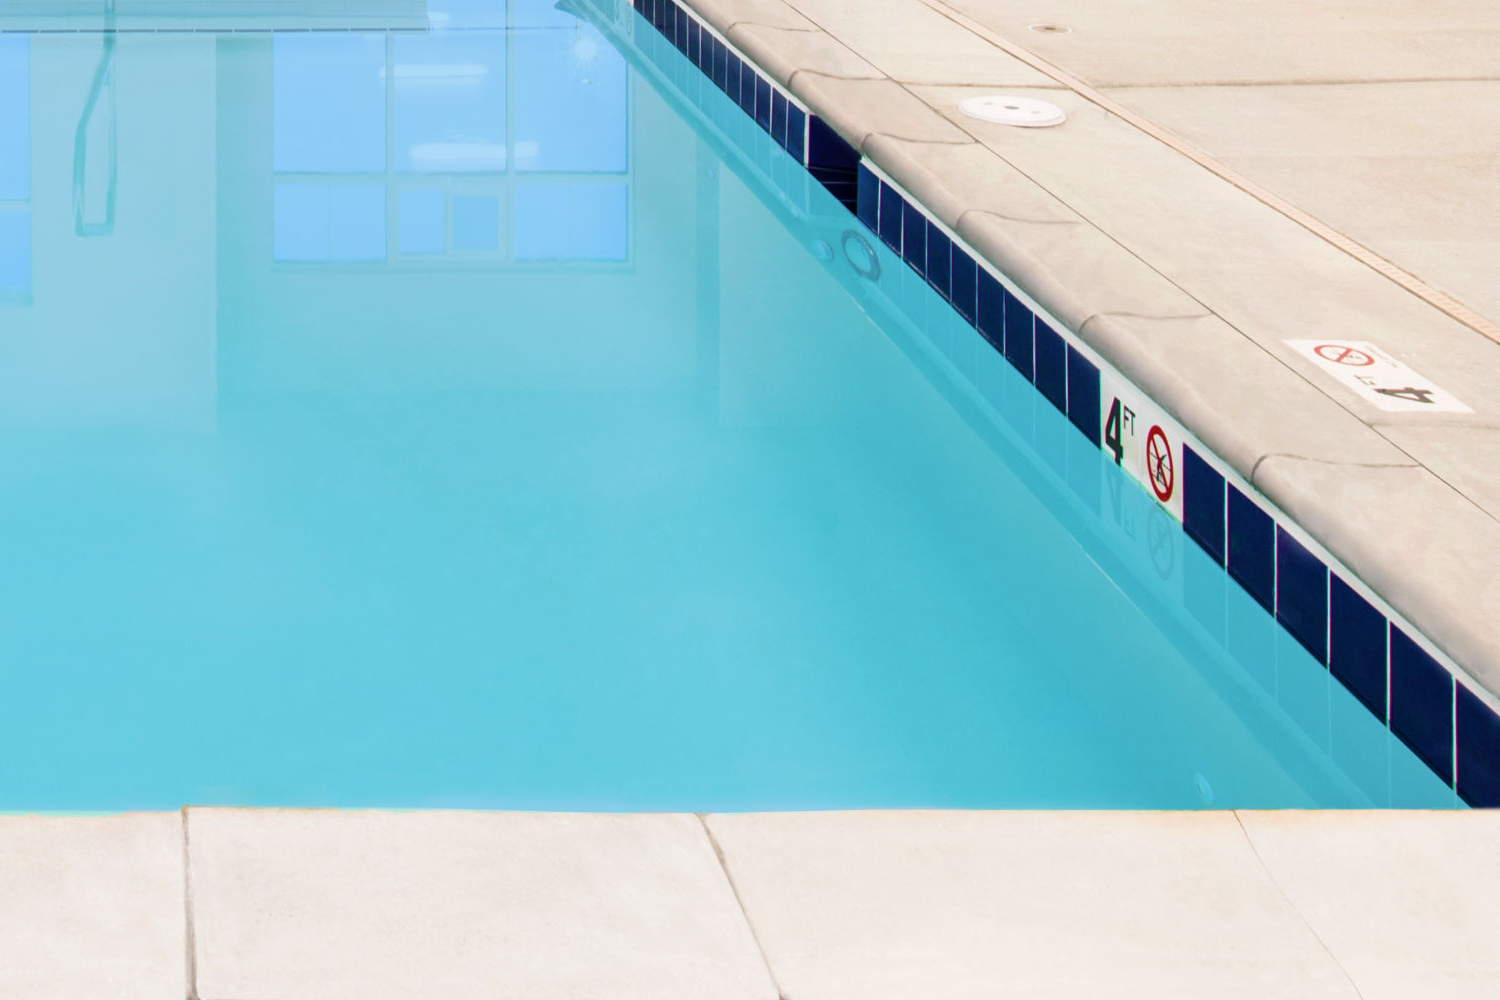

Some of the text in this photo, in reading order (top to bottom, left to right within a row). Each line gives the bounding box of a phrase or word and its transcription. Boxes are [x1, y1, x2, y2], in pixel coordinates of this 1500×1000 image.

[1372, 386, 1437, 405] 4
[1105, 397, 1136, 468] 4 FT
